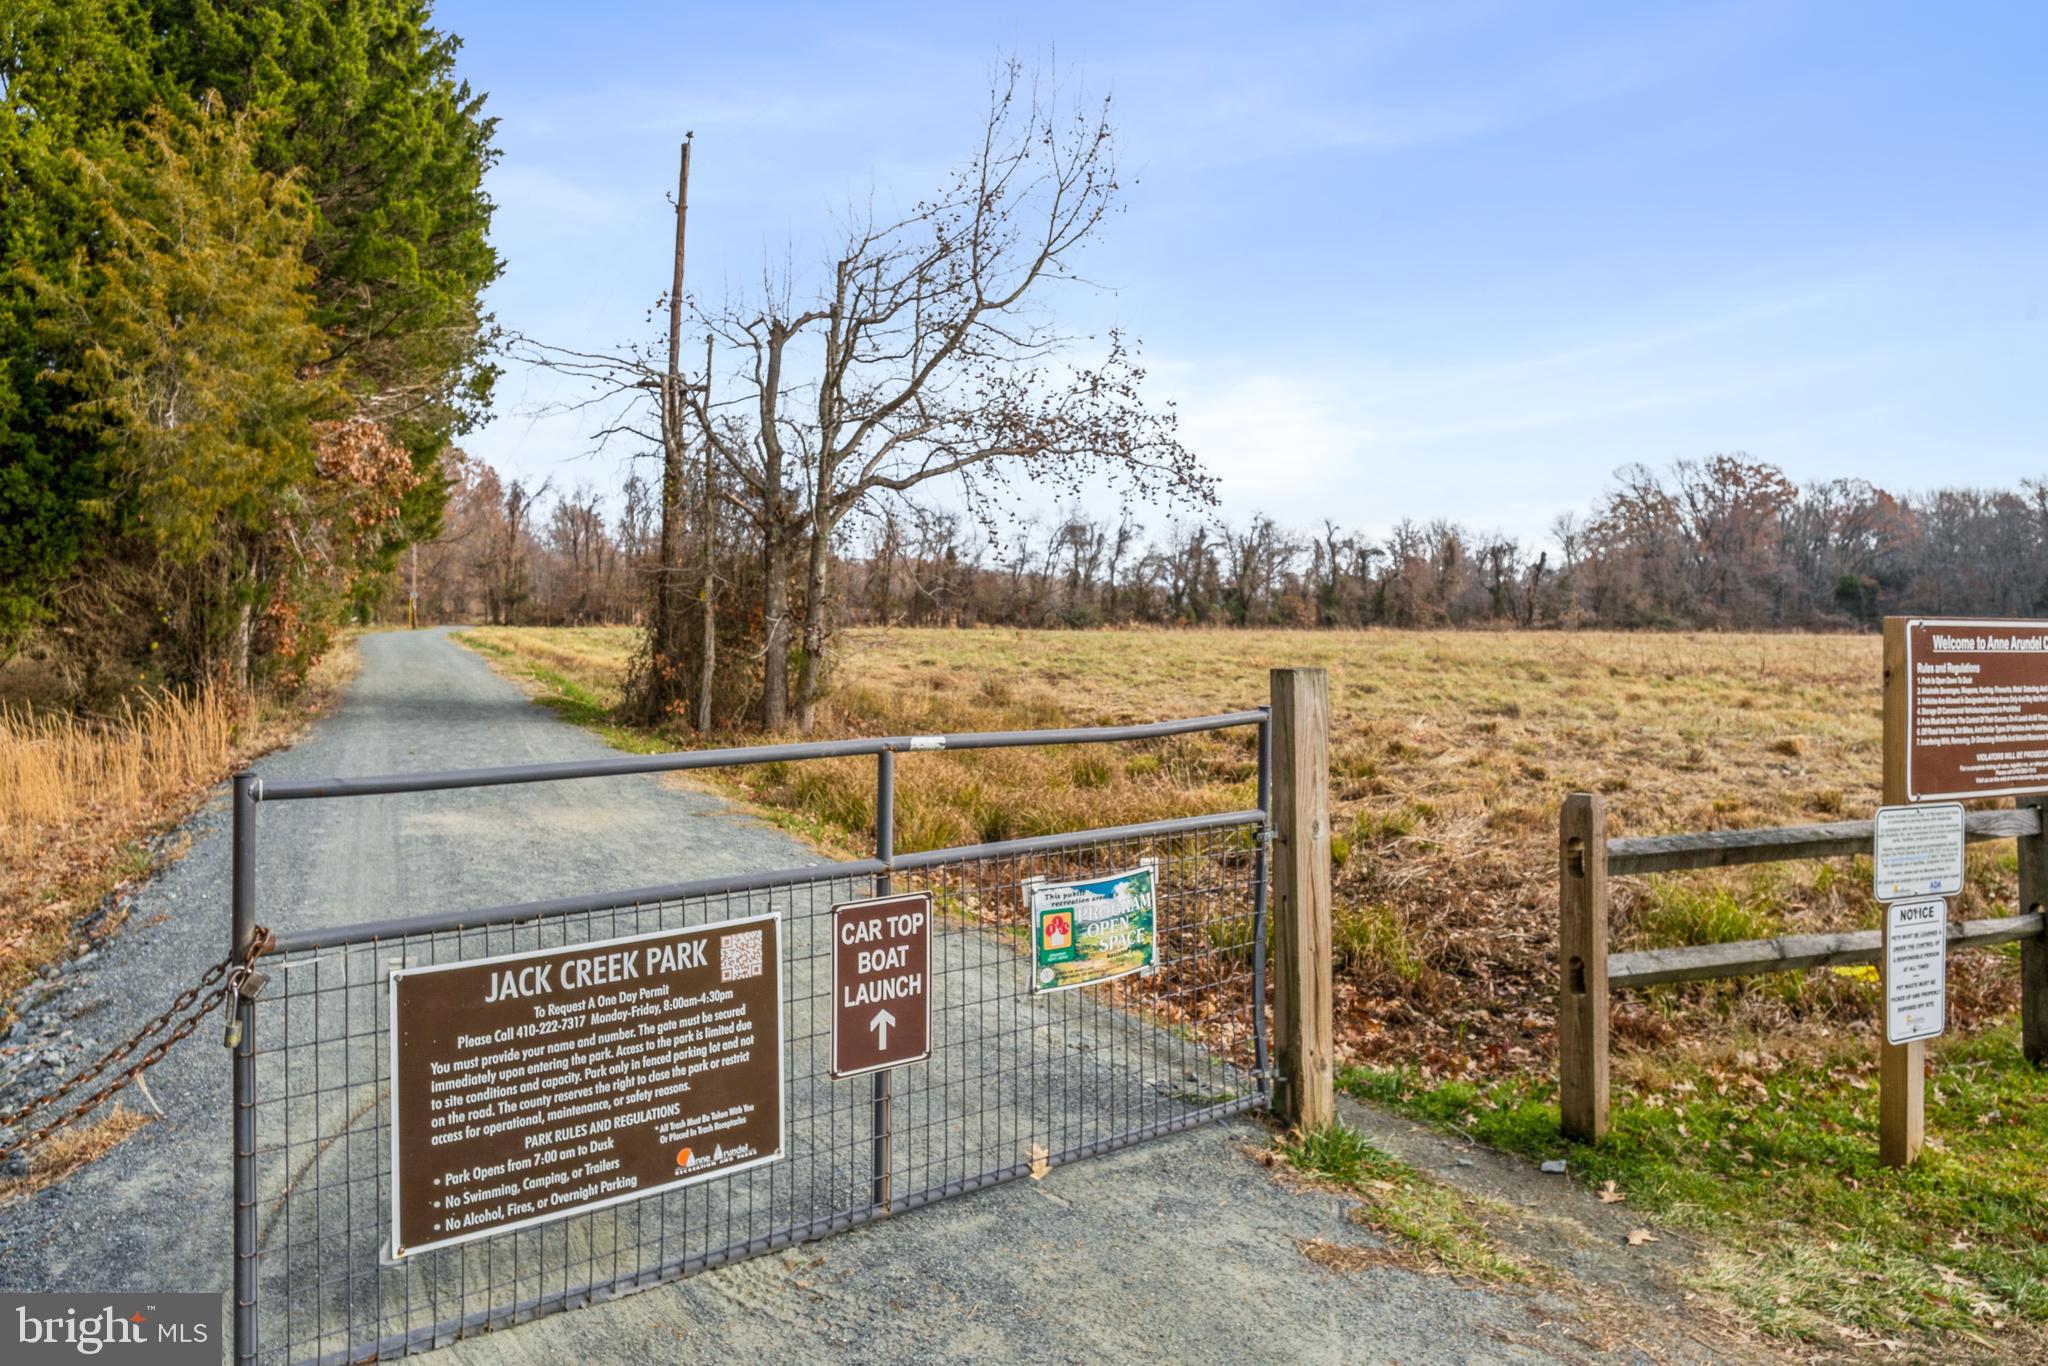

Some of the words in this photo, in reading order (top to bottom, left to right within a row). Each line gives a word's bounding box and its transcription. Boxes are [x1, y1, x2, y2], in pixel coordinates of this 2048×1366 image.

[1933, 635, 1975, 650] Welcome
[1977, 637, 1986, 650] to
[1987, 636, 2009, 650] Anne
[2011, 636, 2042, 650] Arundel
[841, 918, 882, 945] CAR
[887, 913, 924, 936] TOP
[1075, 893, 1151, 922] PROGRAM
[1087, 915, 1130, 937] OPEN
[1900, 906, 1934, 921] NOTICE
[858, 945, 909, 974] BOAT
[1099, 927, 1145, 952] SPACE
[484, 964, 552, 1002] JACK
[560, 950, 638, 989] CREEK
[646, 938, 707, 975] PARK
[844, 973, 921, 1008] LAUNCH
[457, 1034, 491, 1048] Please
[494, 1026, 513, 1042] Call
[516, 1014, 585, 1038] 410-222-7317
[590, 1002, 661, 1025] Monday-Friday,
[663, 989, 733, 1011] 8:00am-4:30pm
[533, 1005, 545, 1018] To
[547, 999, 586, 1016] Request
[587, 996, 595, 1009] A
[597, 994, 616, 1007] One
[618, 991, 637, 1003] Day
[639, 984, 669, 999] Permit
[430, 1061, 450, 1075] You
[453, 1056, 479, 1071] must
[481, 1047, 520, 1069] provide
[522, 1046, 545, 1061] your
[547, 1040, 575, 1053] name
[577, 1032, 595, 1048] and
[597, 1027, 636, 1044] number.
[637, 1022, 655, 1035] The
[656, 1019, 677, 1034] gate
[678, 1014, 700, 1028] must
[701, 1011, 713, 1023] be
[714, 1003, 745, 1021] secured
[431, 1069, 496, 1092] immediately
[499, 1066, 524, 1081] upon
[527, 1057, 568, 1074] entering
[570, 1052, 586, 1065] the
[588, 1046, 613, 1065] park.
[615, 1043, 644, 1057] Access
[645, 1040, 655, 1050] to
[656, 1035, 671, 1048] the
[673, 1029, 694, 1047] park
[695, 1029, 703, 1040] is
[704, 1021, 734, 1038] limited
[735, 1019, 752, 1032] due
[431, 1099, 442, 1110] to
[444, 1094, 463, 1108] site
[465, 1085, 517, 1103] conditions
[519, 1077, 539, 1092] and
[541, 1071, 582, 1088] capacity.
[584, 1064, 607, 1079] Park
[608, 1060, 629, 1074] only
[630, 1058, 640, 1070] in
[642, 1050, 671, 1067] fenced
[673, 1045, 707, 1063] parking
[708, 1041, 720, 1053] lot
[721, 1036, 738, 1050] and
[740, 1034, 754, 1046] not
[431, 1116, 445, 1128] on
[447, 1110, 465, 1124] the
[467, 1103, 495, 1120] road.
[497, 1100, 517, 1114] The
[519, 1094, 552, 1110] county
[553, 1086, 593, 1102] reserves
[594, 1081, 610, 1094] the
[612, 1075, 635, 1090] right
[636, 1074, 646, 1085] to
[647, 1069, 670, 1082] close
[671, 1064, 686, 1077] the
[687, 1058, 708, 1076] park
[709, 1059, 720, 1069] or
[721, 1050, 749, 1066] restrict
[431, 1130, 463, 1145] access
[465, 1125, 480, 1138] for
[483, 1110, 544, 1136] operational,
[547, 1099, 611, 1121] maintenance,
[613, 1096, 624, 1106] or
[625, 1089, 653, 1104] safety
[654, 1082, 690, 1097] reasons.
[524, 1131, 552, 1148] PARK
[554, 1123, 587, 1142] RULES
[589, 1118, 611, 1134] AND
[613, 1102, 680, 1128] REGULATIONS
[445, 1168, 470, 1186] Park
[472, 1164, 505, 1180] Opens
[507, 1158, 531, 1172] from
[534, 1149, 557, 1165] 7:00
[559, 1148, 575, 1160] am
[577, 1145, 587, 1155] to
[589, 1136, 614, 1152] Dusk
[445, 1194, 460, 1208] No
[463, 1183, 520, 1204] Swimming,
[522, 1172, 569, 1190] Camping,
[571, 1168, 583, 1178] or
[584, 1158, 619, 1175] Trailers
[445, 1217, 461, 1231] No
[463, 1205, 504, 1227] Alcohol,
[507, 1201, 534, 1216] Fires,
[536, 1198, 548, 1208] or
[550, 1183, 598, 1205] Overnight
[600, 1175, 637, 1193] Parking
